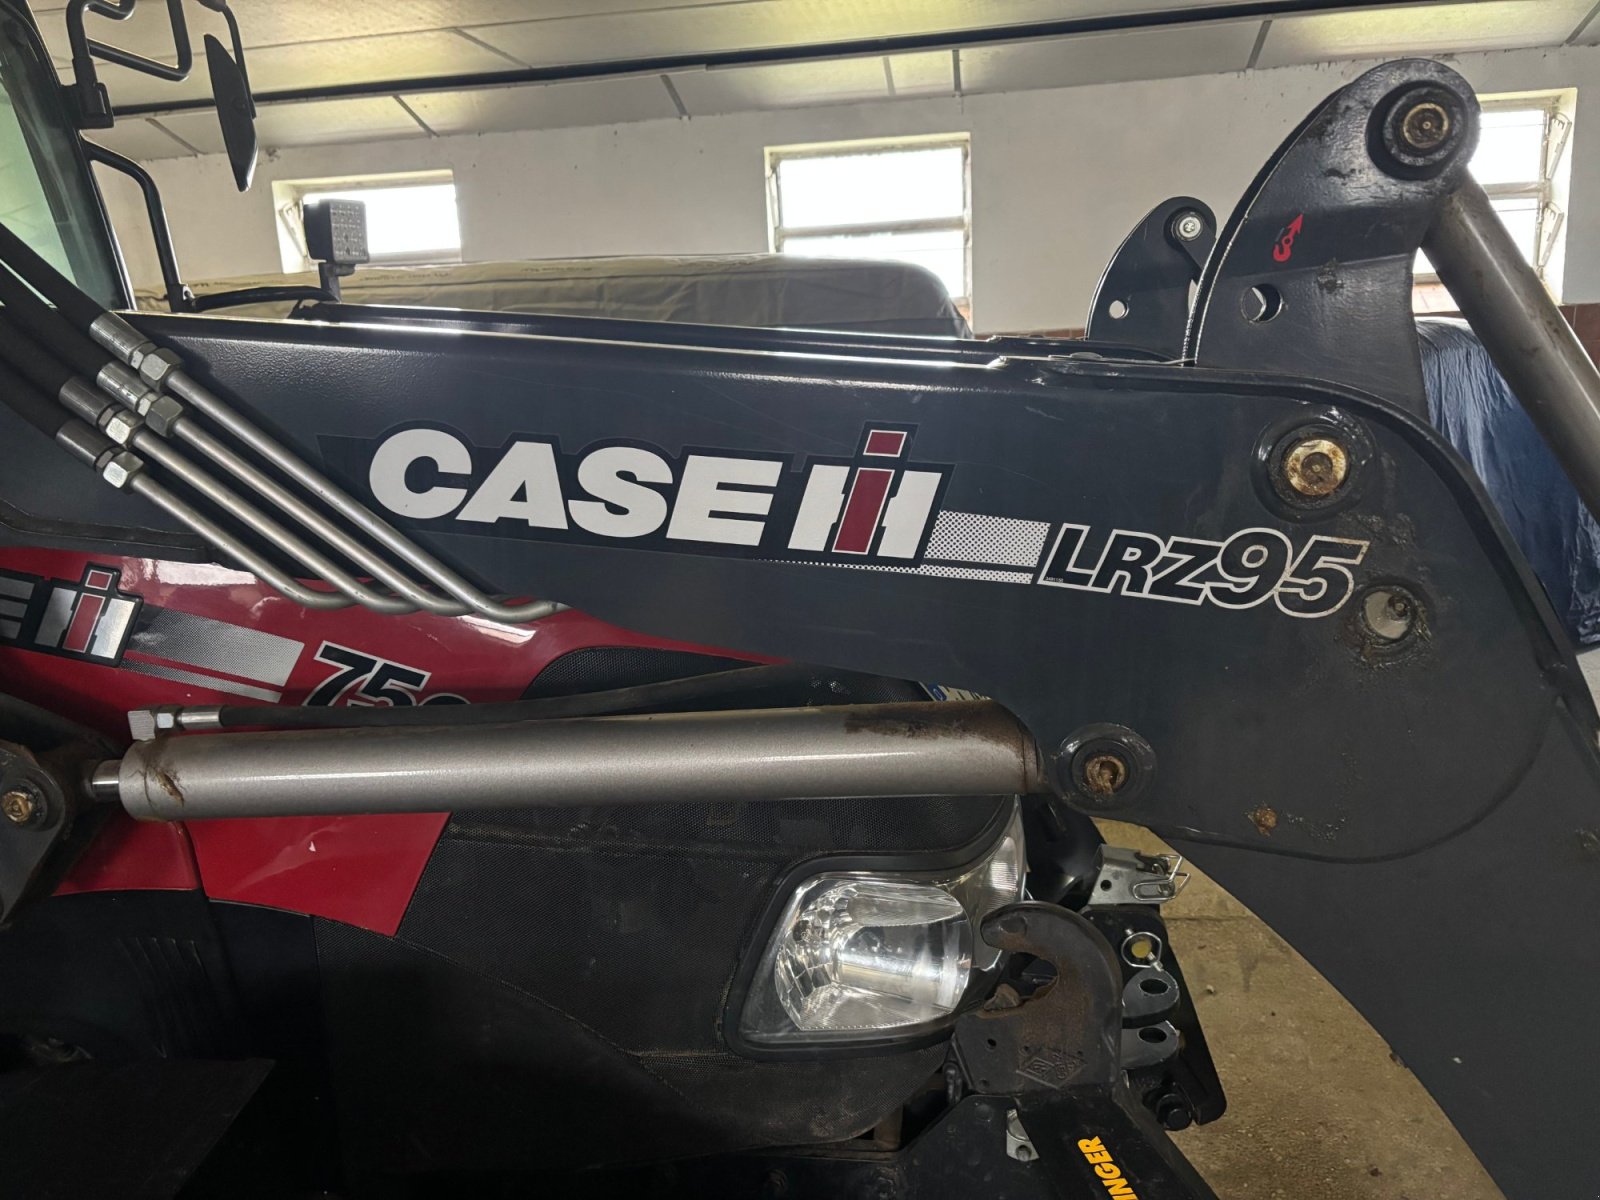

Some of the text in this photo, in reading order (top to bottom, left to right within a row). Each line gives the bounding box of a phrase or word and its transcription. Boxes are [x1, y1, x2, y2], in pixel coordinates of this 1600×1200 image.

[369, 428, 783, 546] CASE
[1037, 522, 1370, 619] LRZ95
[301, 640, 473, 707] 75
